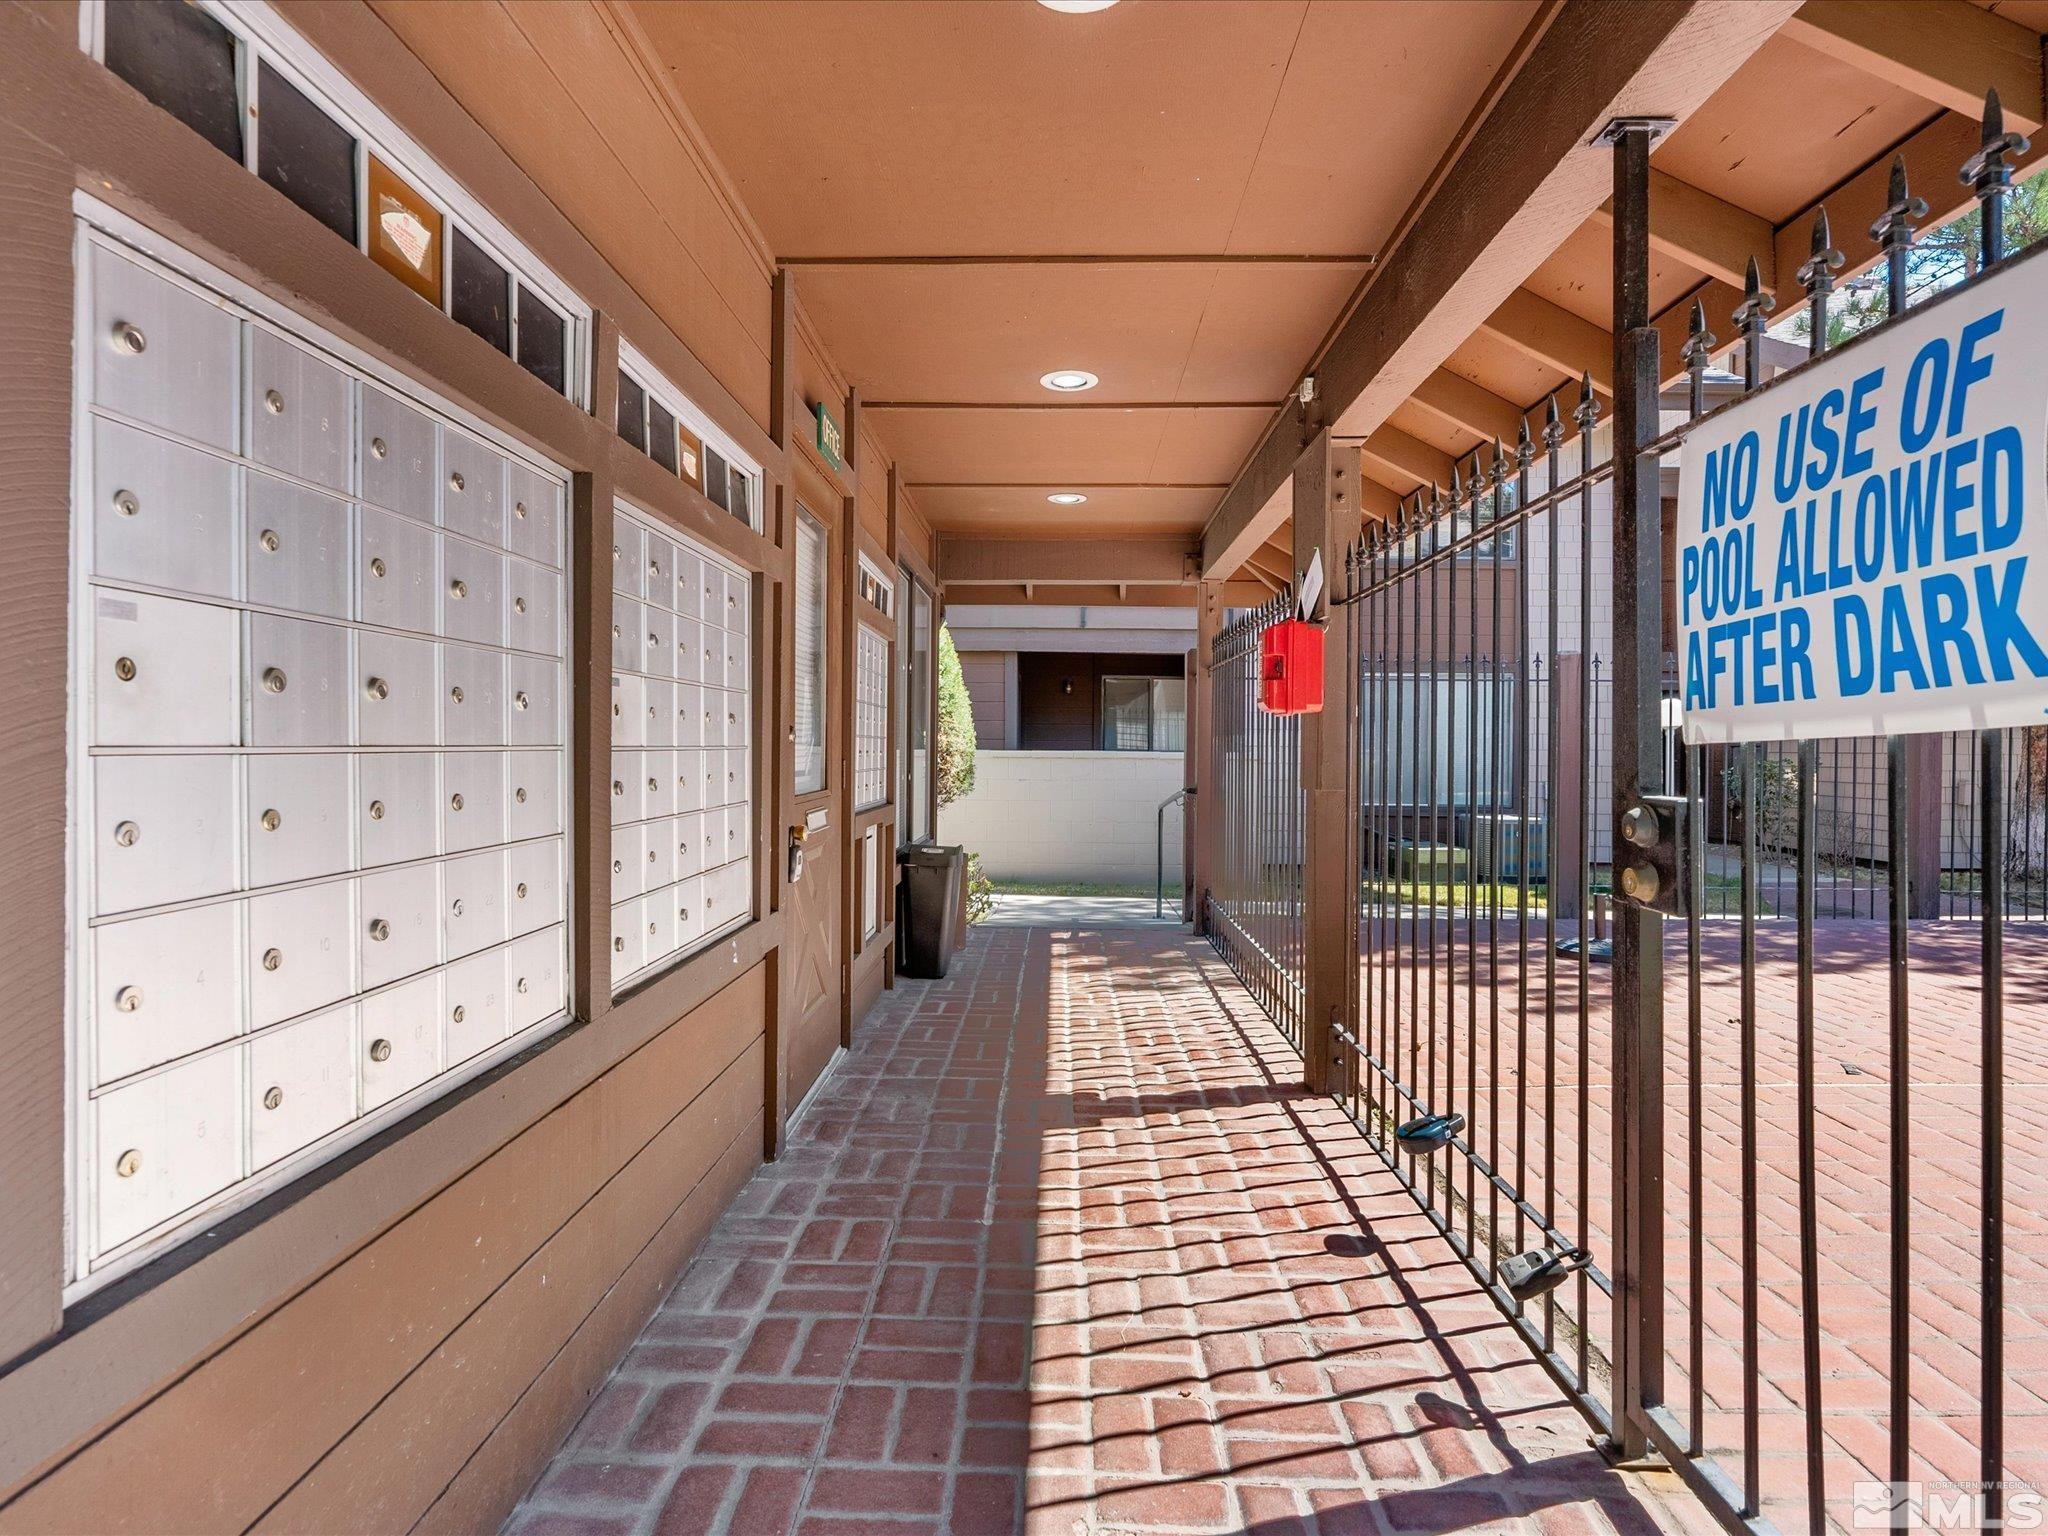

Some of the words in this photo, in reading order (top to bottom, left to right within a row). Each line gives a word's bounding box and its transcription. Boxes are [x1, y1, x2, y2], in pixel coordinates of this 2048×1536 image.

[1701, 430, 1760, 533] NO
[1773, 366, 1886, 504] USE
[1899, 307, 2005, 454] OF
[1682, 522, 1763, 627] POOL
[1773, 425, 2024, 604] ALLOWED
[1684, 606, 1817, 712] AFTER
[1832, 556, 2048, 698] DARK
